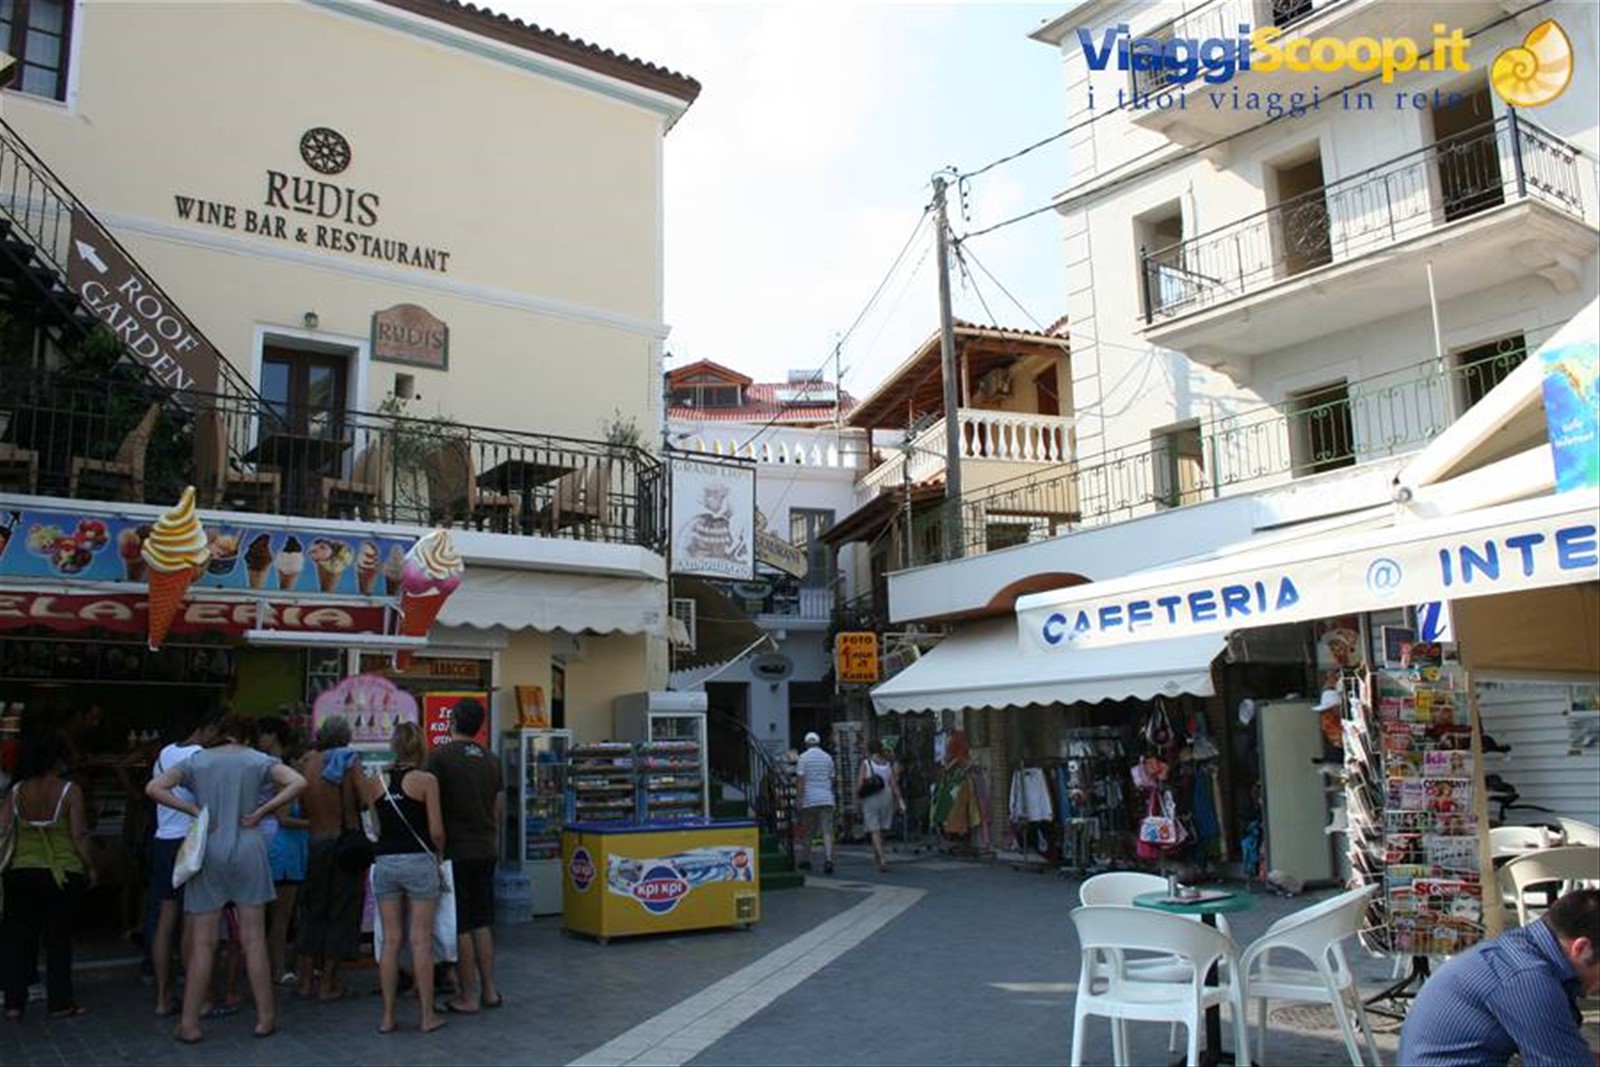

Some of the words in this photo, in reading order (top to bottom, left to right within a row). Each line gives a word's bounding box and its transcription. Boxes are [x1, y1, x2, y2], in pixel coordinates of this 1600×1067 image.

[174, 195, 237, 230] WINE
[243, 209, 288, 240] BAR
[295, 227, 309, 244] &
[315, 224, 451, 273] RESTAURANT
[81, 280, 196, 390] GARDEN
[118, 275, 200, 352] ROOF
[1438, 524, 1599, 588] INTE
[0, 595, 354, 630] ELAERIA
